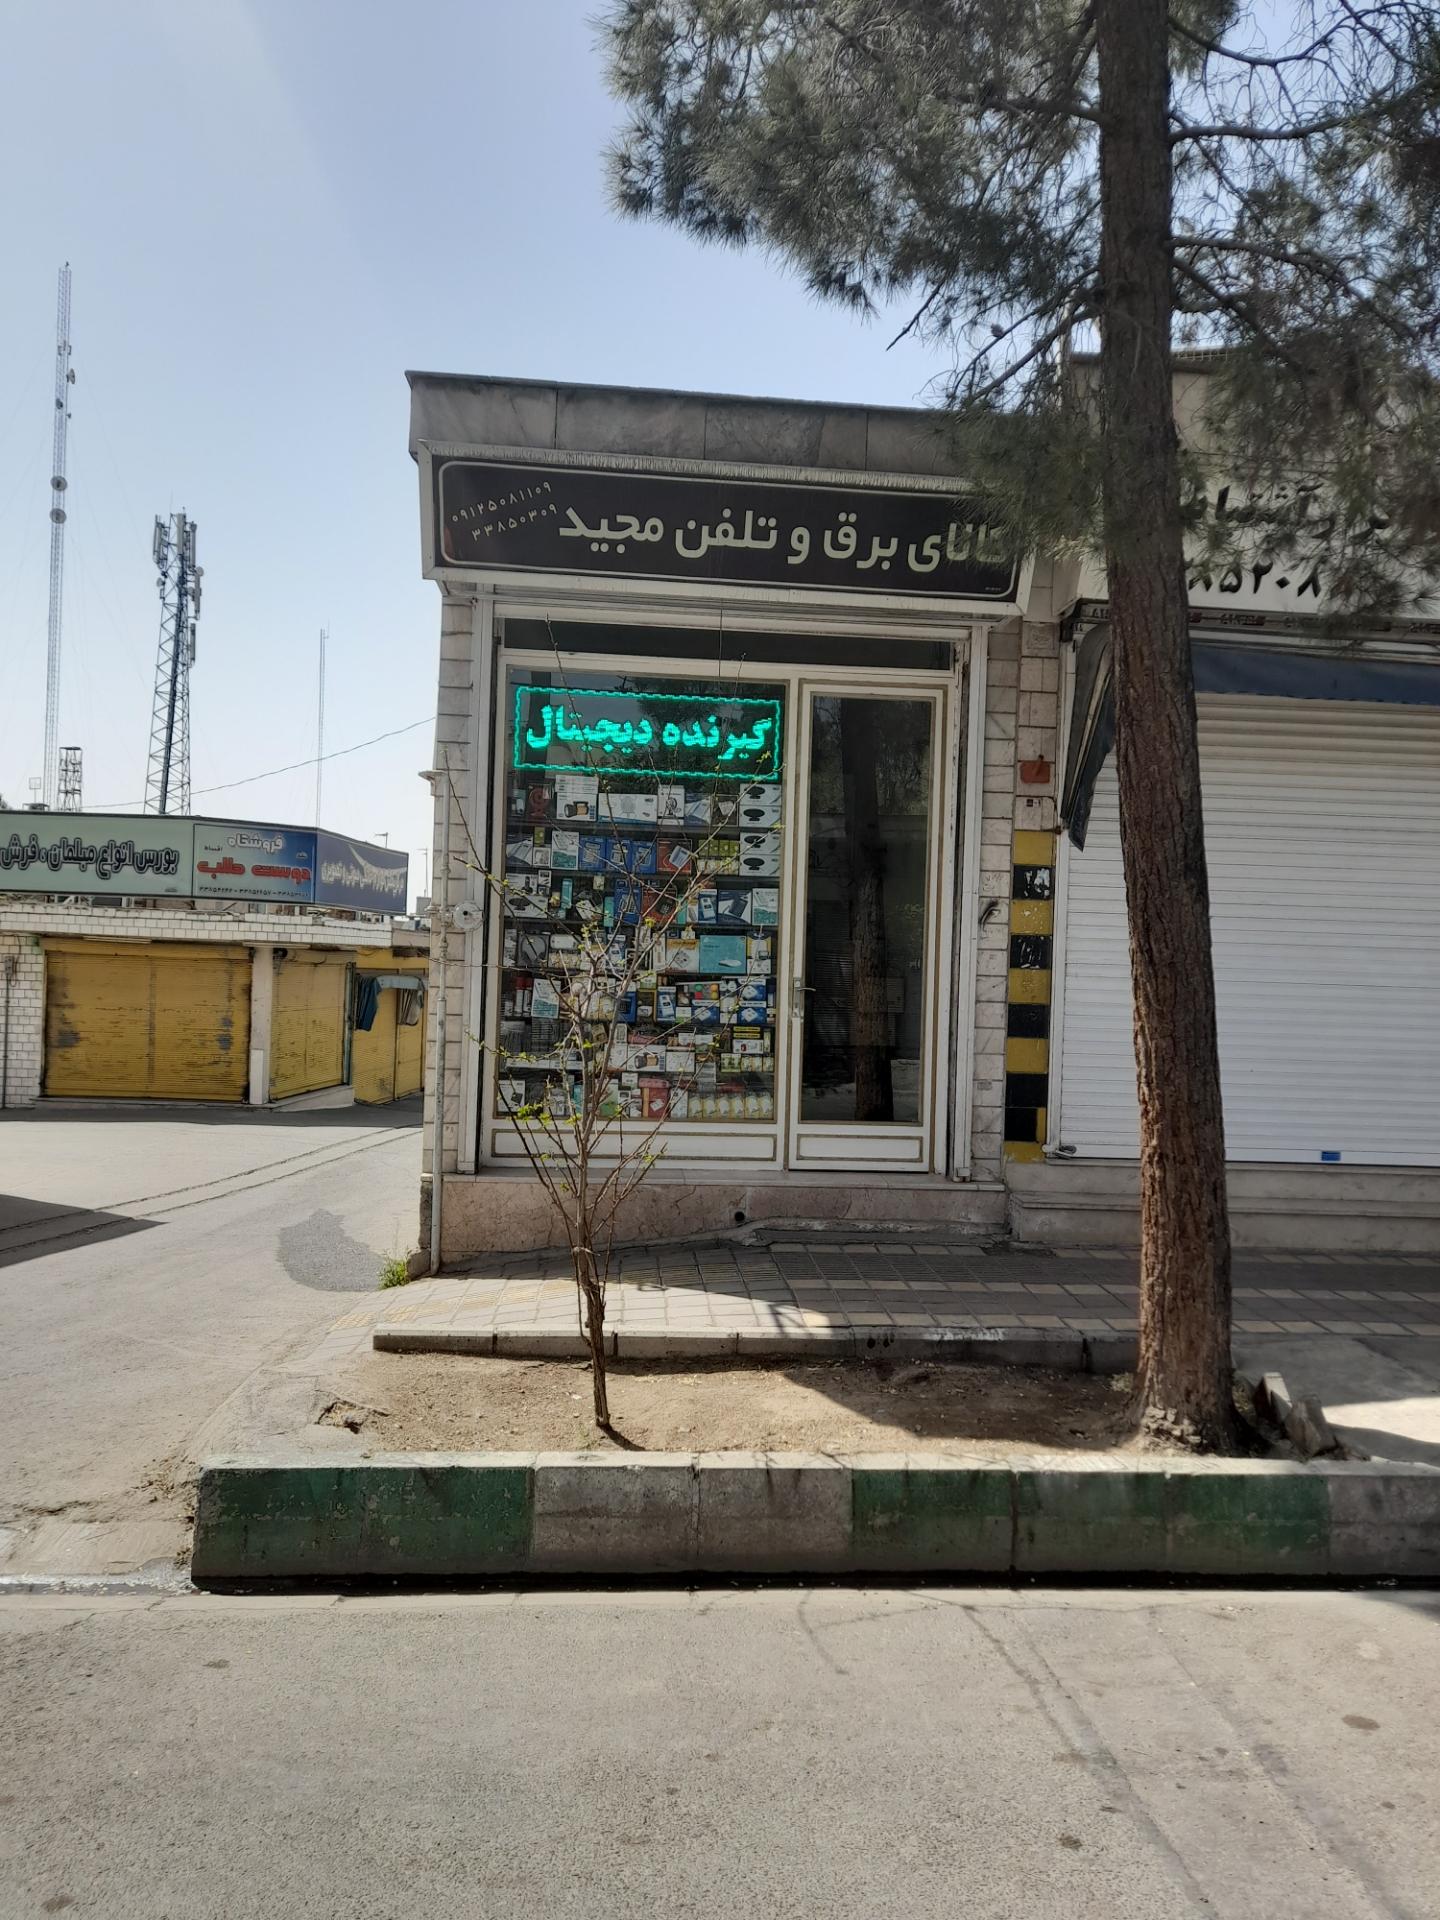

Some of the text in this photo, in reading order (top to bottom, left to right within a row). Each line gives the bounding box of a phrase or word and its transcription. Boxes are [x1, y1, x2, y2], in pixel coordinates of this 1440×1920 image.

[452, 481, 552, 522] ۰۹۱۲۵۰۸۱۱۰۹
[471, 503, 558, 541] ۳۳۸۵۰۳۰۹
[558, 506, 665, 554] مجید
[675, 507, 779, 559] تلفن
[823, 512, 899, 570] برق
[787, 525, 811, 565] و
[526, 704, 653, 754] دیجیتال
[0, 833, 40, 870] فرش
[96, 839, 135, 880] انواع
[133, 847, 180, 875] بورس
[227, 832, 285, 854] فروشگاه
[197, 856, 246, 880] طلب
[251, 864, 312, 885] دوست
